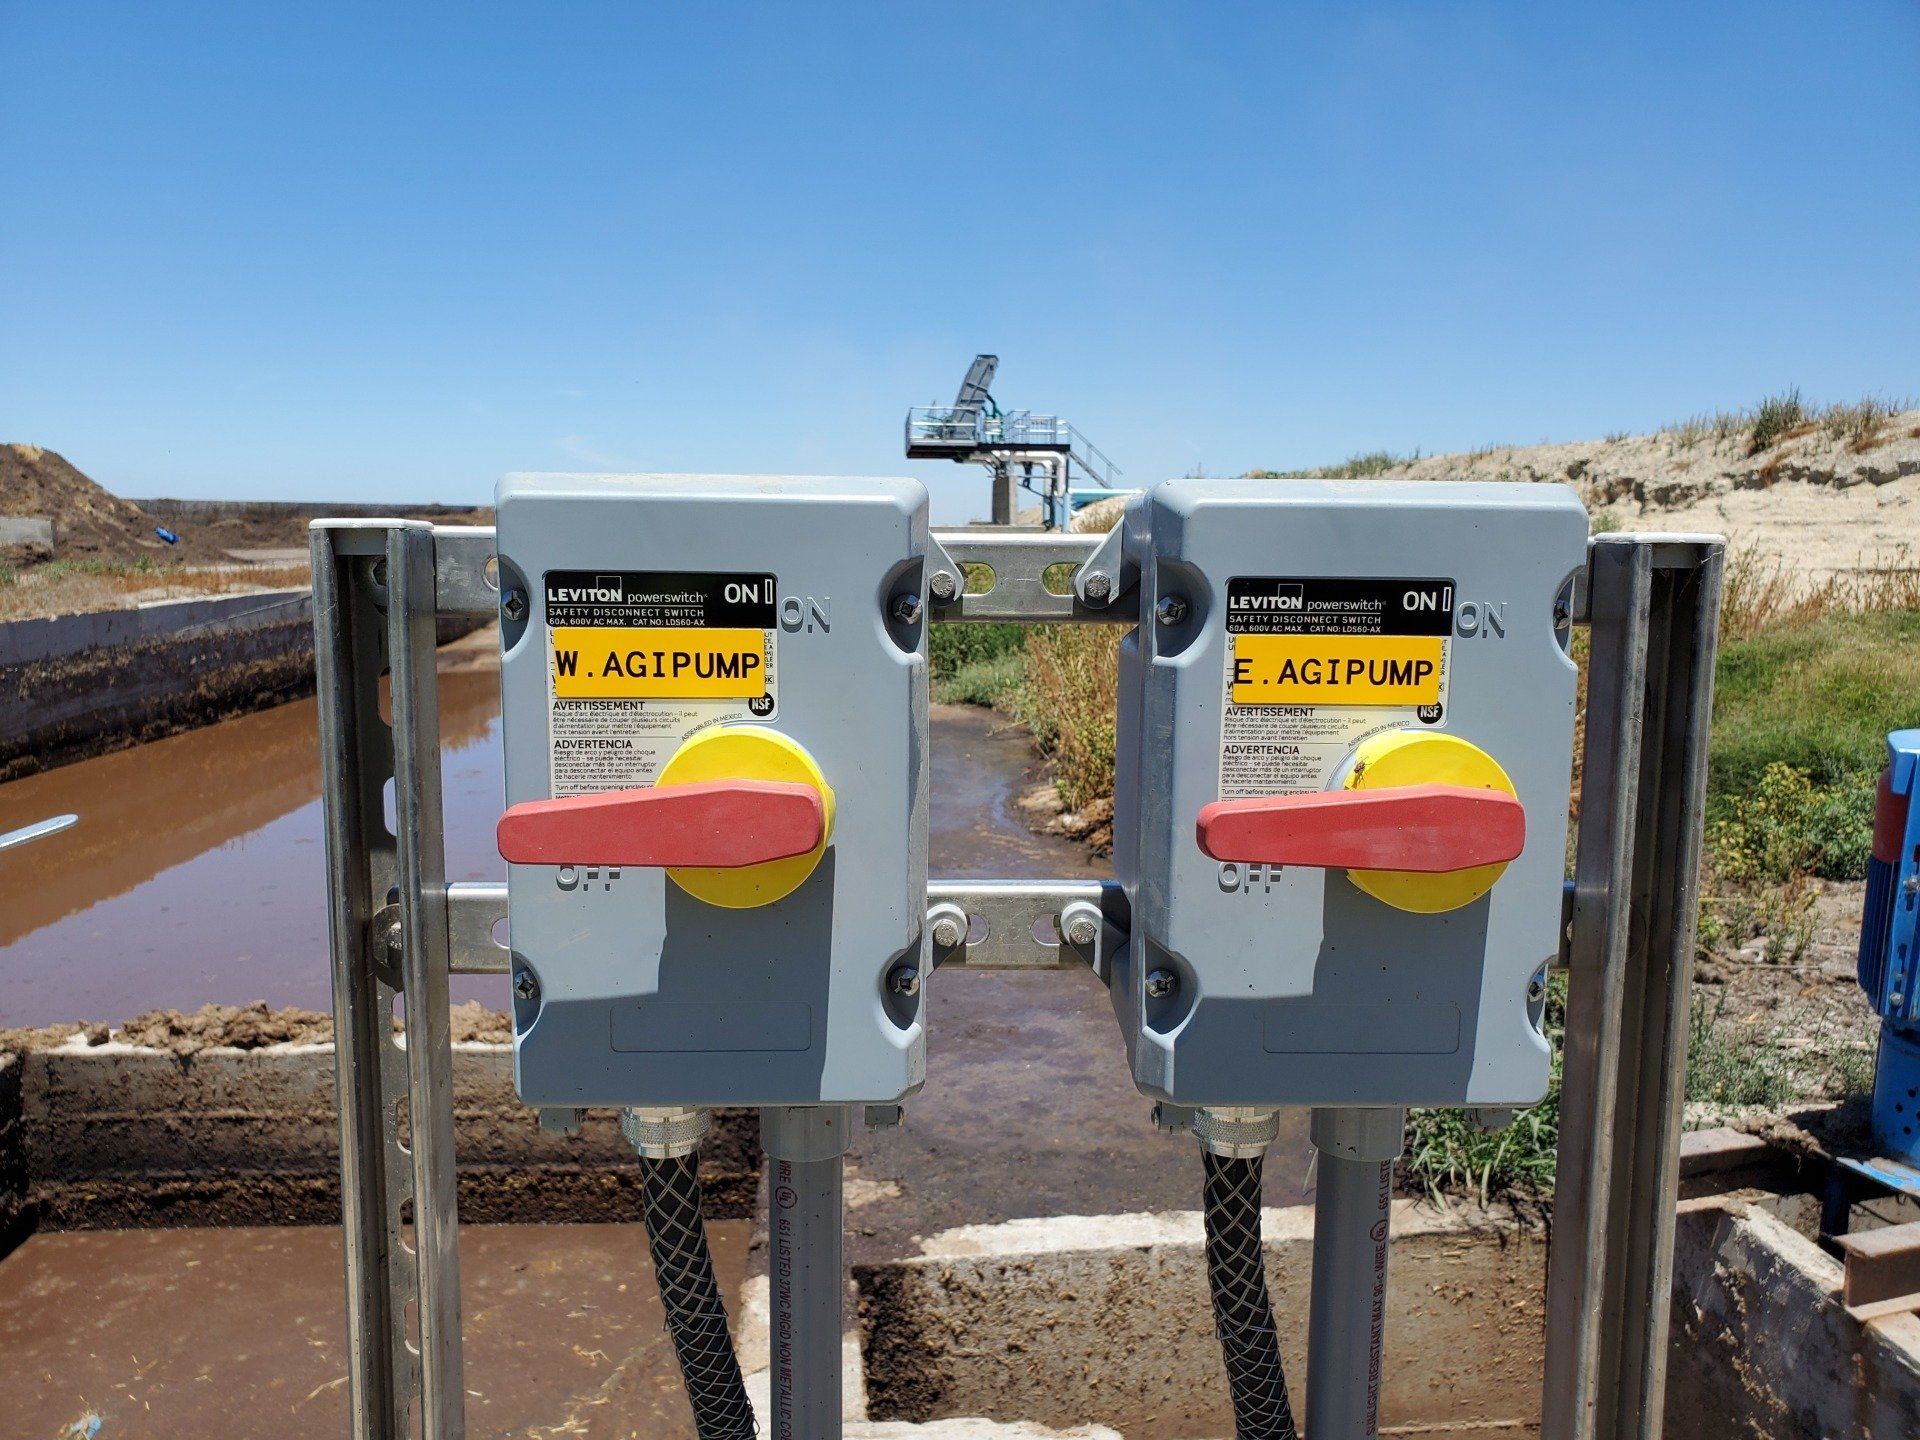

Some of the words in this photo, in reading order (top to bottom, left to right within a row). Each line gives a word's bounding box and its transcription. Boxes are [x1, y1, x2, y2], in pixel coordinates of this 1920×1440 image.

[548, 589, 622, 602] LEVITON
[628, 591, 703, 604] powerswitch
[724, 583, 758, 603] ON
[1230, 596, 1303, 609] LEVITON
[1307, 599, 1382, 612] powerswitch
[1402, 591, 1437, 611] ON
[549, 608, 589, 616] SAFETY
[594, 608, 660, 616] DISCONNECT
[665, 609, 704, 617] SWITCH
[570, 618, 591, 626] 600V
[593, 618, 605, 626] AC
[607, 618, 627, 626] MAX.
[633, 618, 648, 626] CAT
[650, 618, 664, 626] NO:
[665, 618, 705, 626] LDS60-AX
[781, 597, 830, 633] ON
[1342, 616, 1381, 624] SWITCH
[1456, 602, 1507, 638] ON
[1249, 625, 1269, 633] 600V
[1271, 625, 1282, 633] AC
[1284, 625, 1304, 633] MAX.
[1310, 625, 1325, 633] CAT
[1327, 625, 1341, 633] NO:
[1342, 625, 1381, 633] LDS60-AX
[553, 701, 645, 710] AVERTISSEMENT
[751, 698, 771, 710] NSF
[1225, 707, 1315, 716] AVERTISSEMENT
[1420, 705, 1440, 717] NSF
[554, 740, 633, 749] ADVERTENCIA
[1223, 746, 1300, 754] ADVERTENCIA
[556, 866, 621, 891] OFF
[1218, 862, 1282, 893] OFF
[779, 1219, 790, 1237] 651
[779, 1239, 790, 1277] LISTED
[1375, 1243, 1385, 1271] WIRE
[779, 1311, 791, 1340] RIGID
[780, 1343, 791, 1365] NON
[1369, 1324, 1381, 1382] RESISTANT
[780, 1367, 791, 1420] METALLIC
[1366, 1383, 1378, 1436] SUNLIGHT
